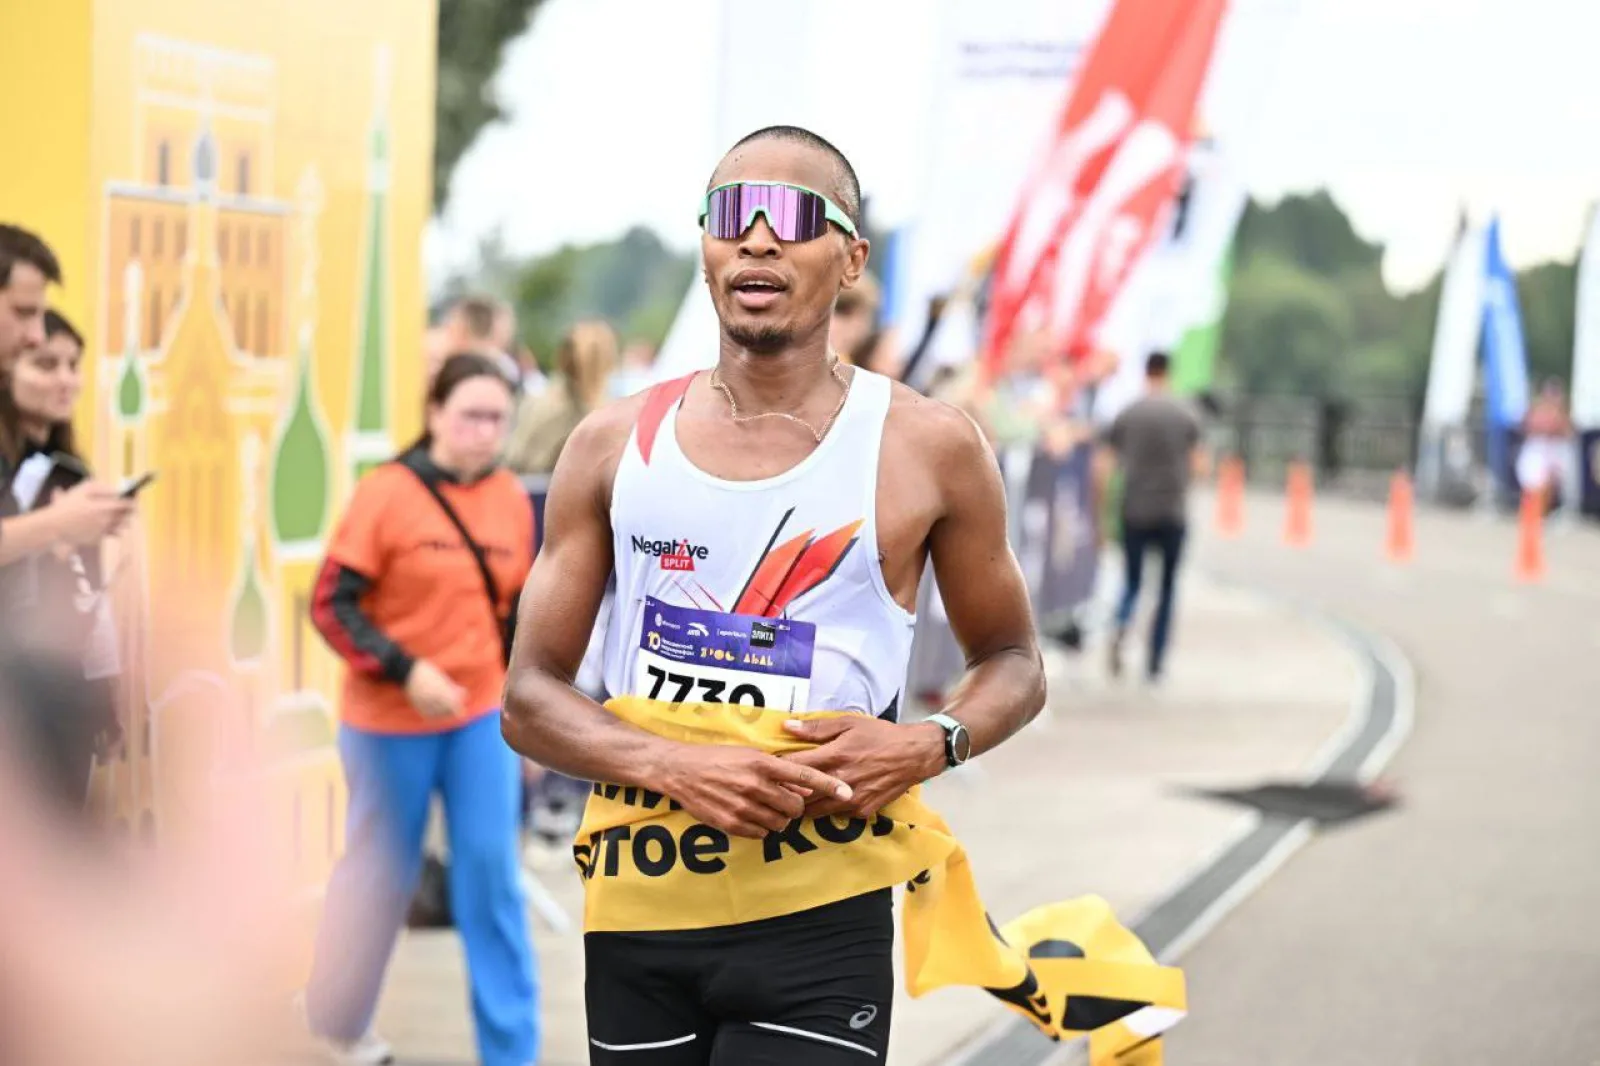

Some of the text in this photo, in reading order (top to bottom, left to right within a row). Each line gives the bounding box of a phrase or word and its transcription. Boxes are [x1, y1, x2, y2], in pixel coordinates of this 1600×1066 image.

[631, 535, 709, 560] Negative
[663, 557, 690, 569] SPLIT
[751, 629, 774, 642] ЭЛИТА
[648, 664, 765, 708] 7730
